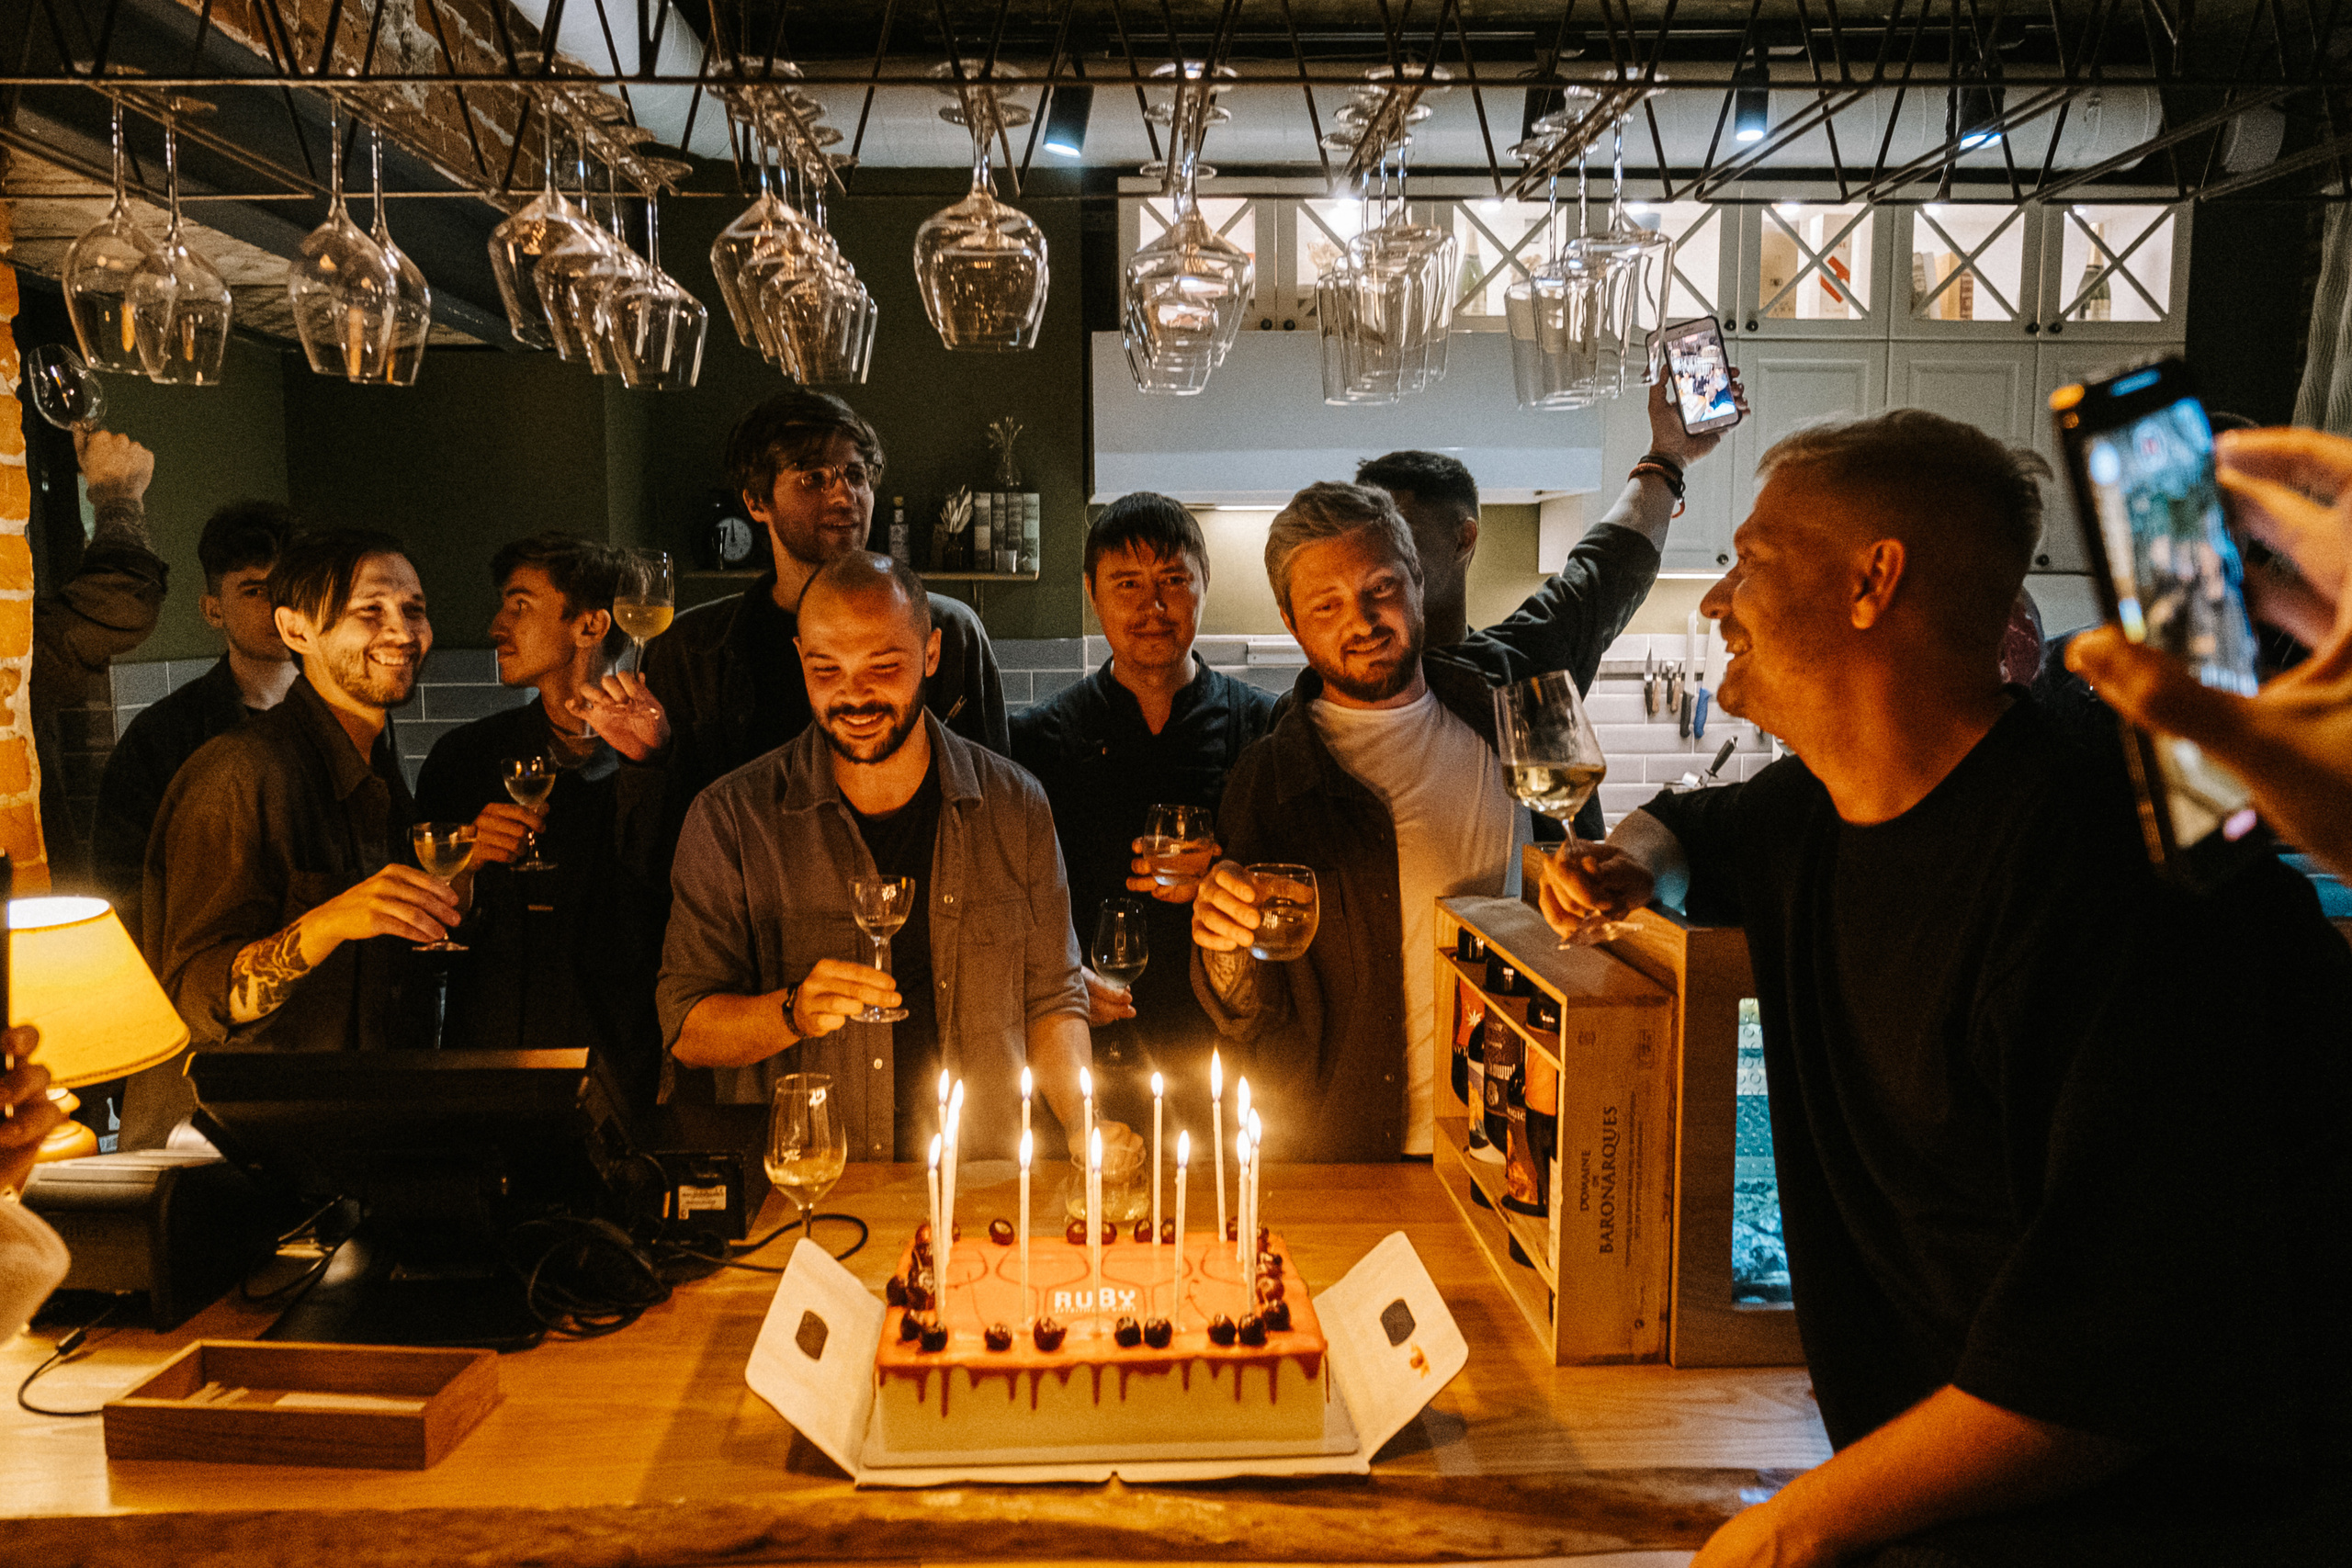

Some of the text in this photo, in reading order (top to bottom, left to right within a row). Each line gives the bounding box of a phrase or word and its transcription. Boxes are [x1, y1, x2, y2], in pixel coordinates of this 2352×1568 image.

[1579, 1149, 1591, 1212] DOMAINE
[1599, 1106, 1621, 1254] BARONARQUES
[1054, 1287, 1136, 1308] RUBY
